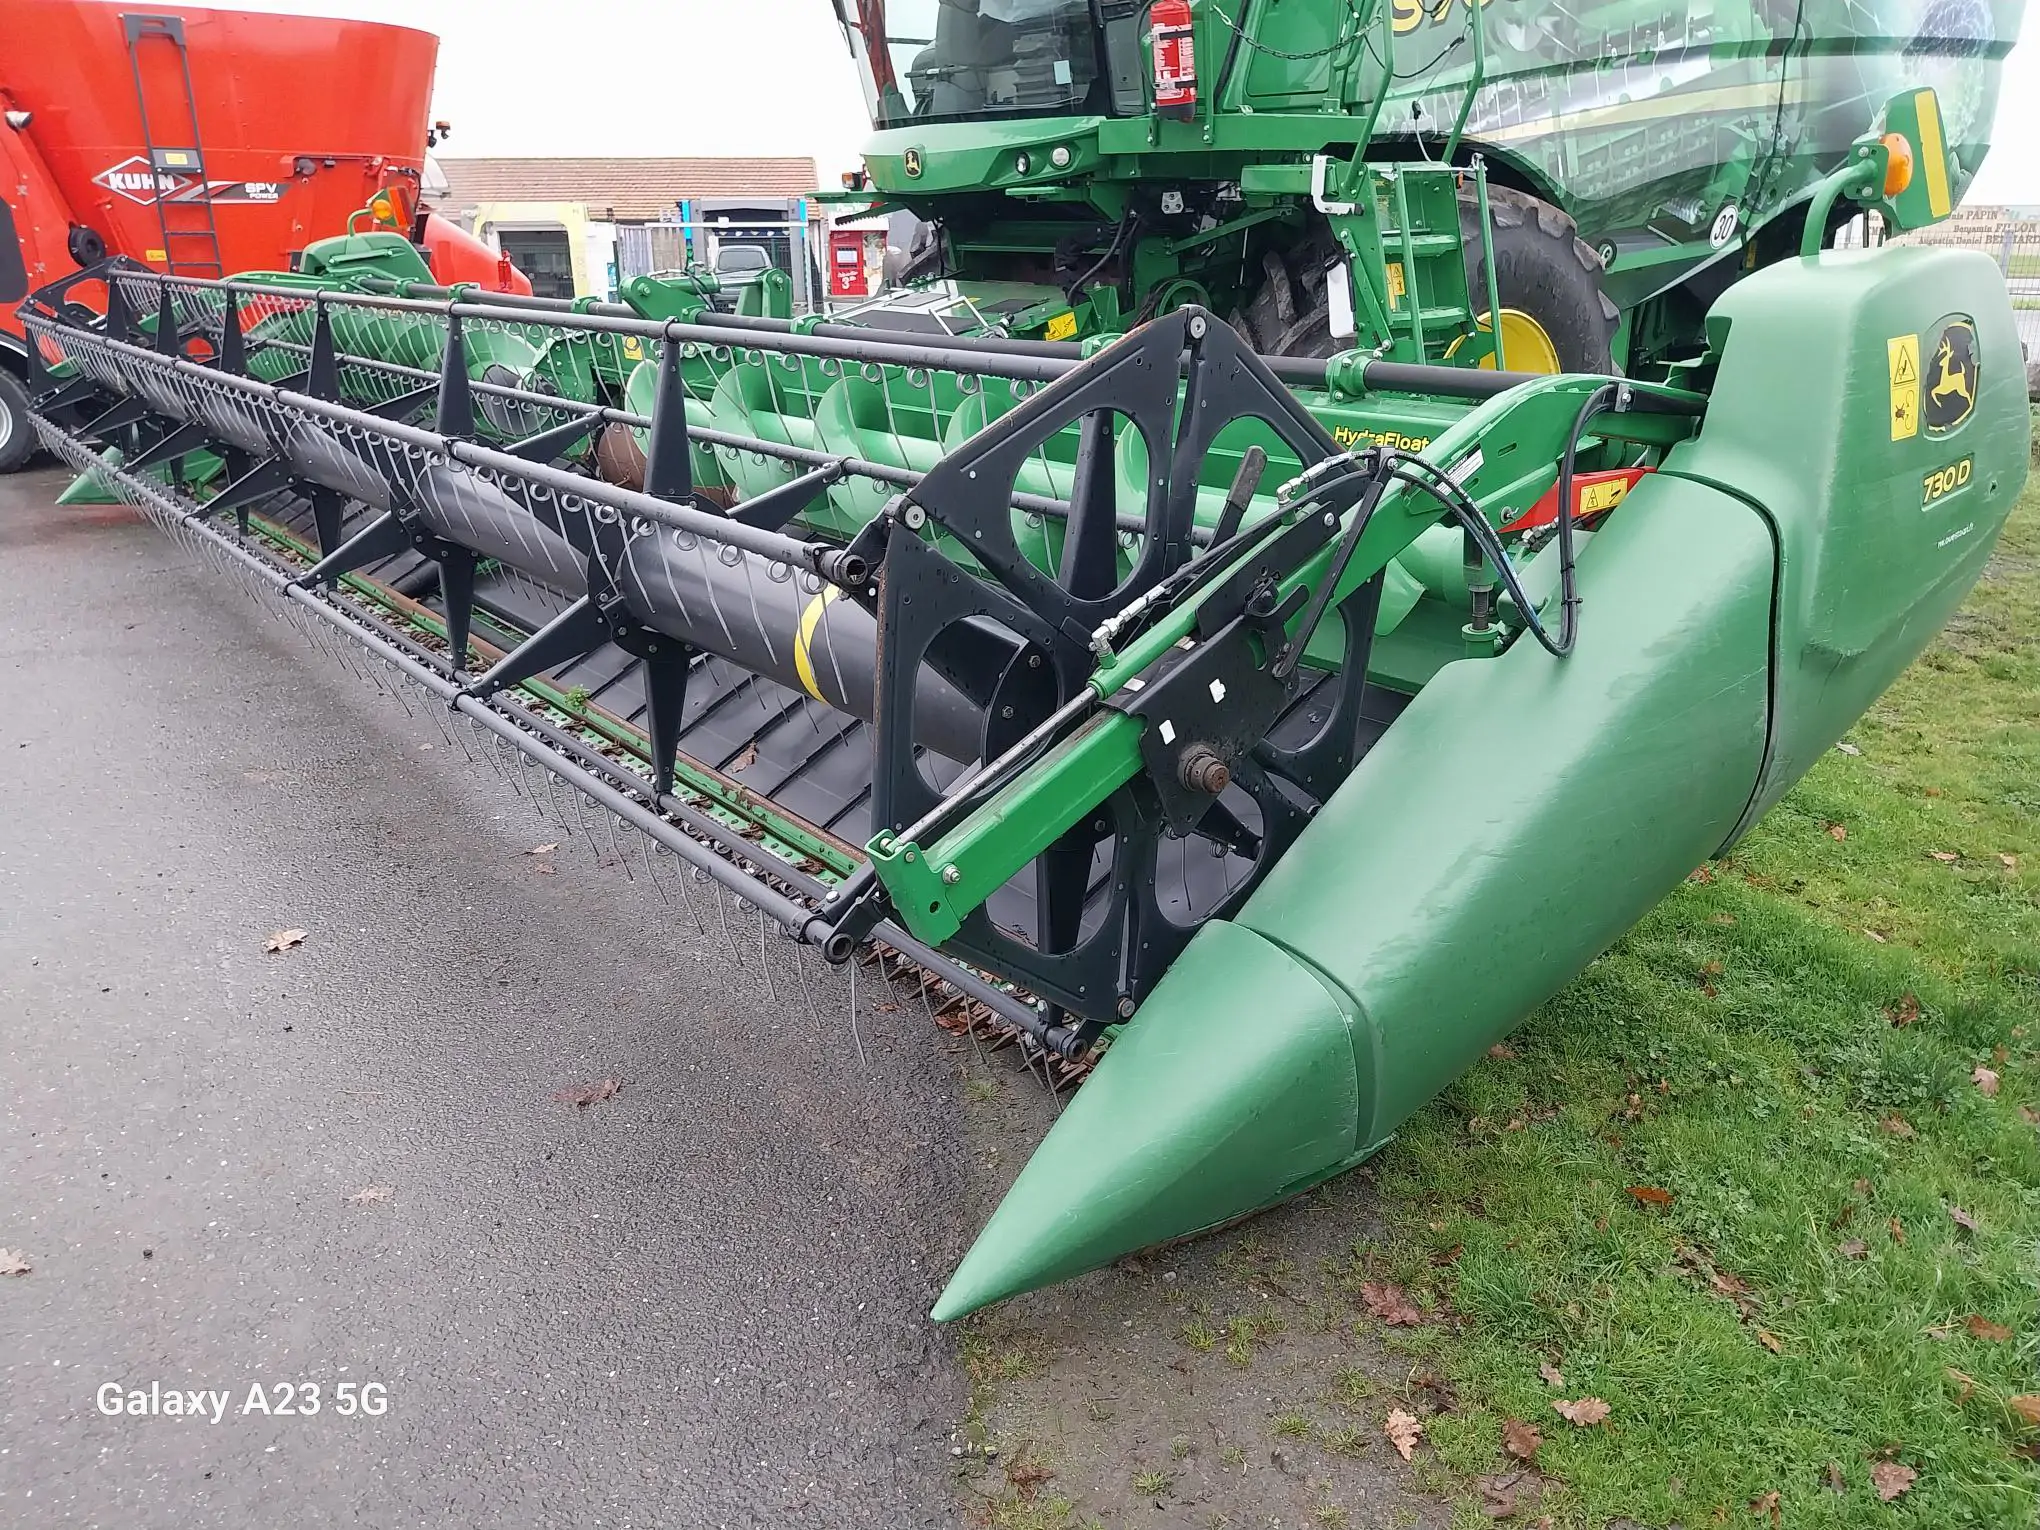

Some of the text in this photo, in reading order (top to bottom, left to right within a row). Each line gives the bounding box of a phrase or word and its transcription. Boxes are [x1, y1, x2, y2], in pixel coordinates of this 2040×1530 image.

[108, 172, 175, 190] KUHN
[244, 182, 277, 193] SPV
[1966, 210, 1998, 221] PAPIN
[1714, 214, 1734, 240] 30
[1953, 223, 1993, 234] Benjamin
[1923, 459, 1971, 504] 730 D
